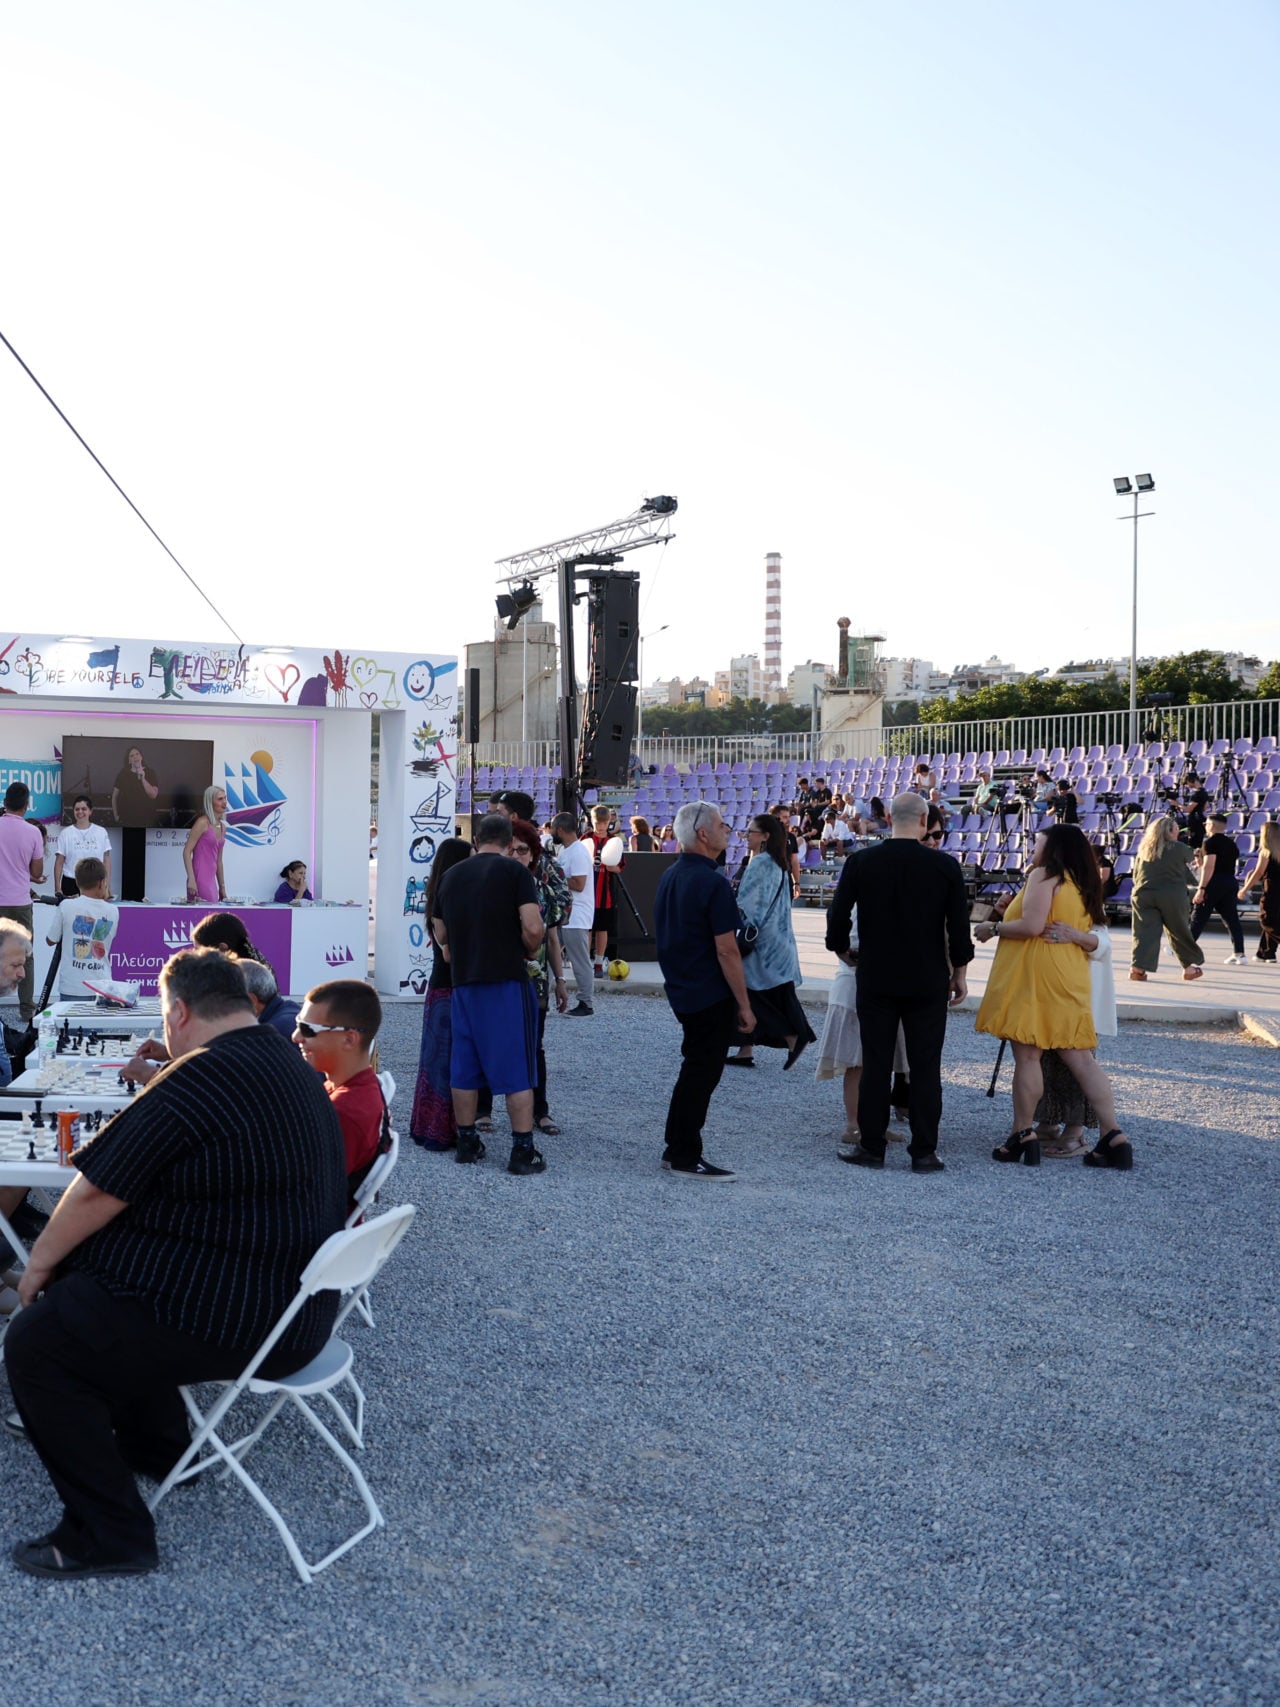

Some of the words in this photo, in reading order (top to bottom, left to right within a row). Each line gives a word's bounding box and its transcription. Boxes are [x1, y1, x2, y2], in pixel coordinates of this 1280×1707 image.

[48, 669, 66, 684] BE
[72, 670, 140, 685] YOURSELF
[110, 953, 165, 968] Πλεύση
